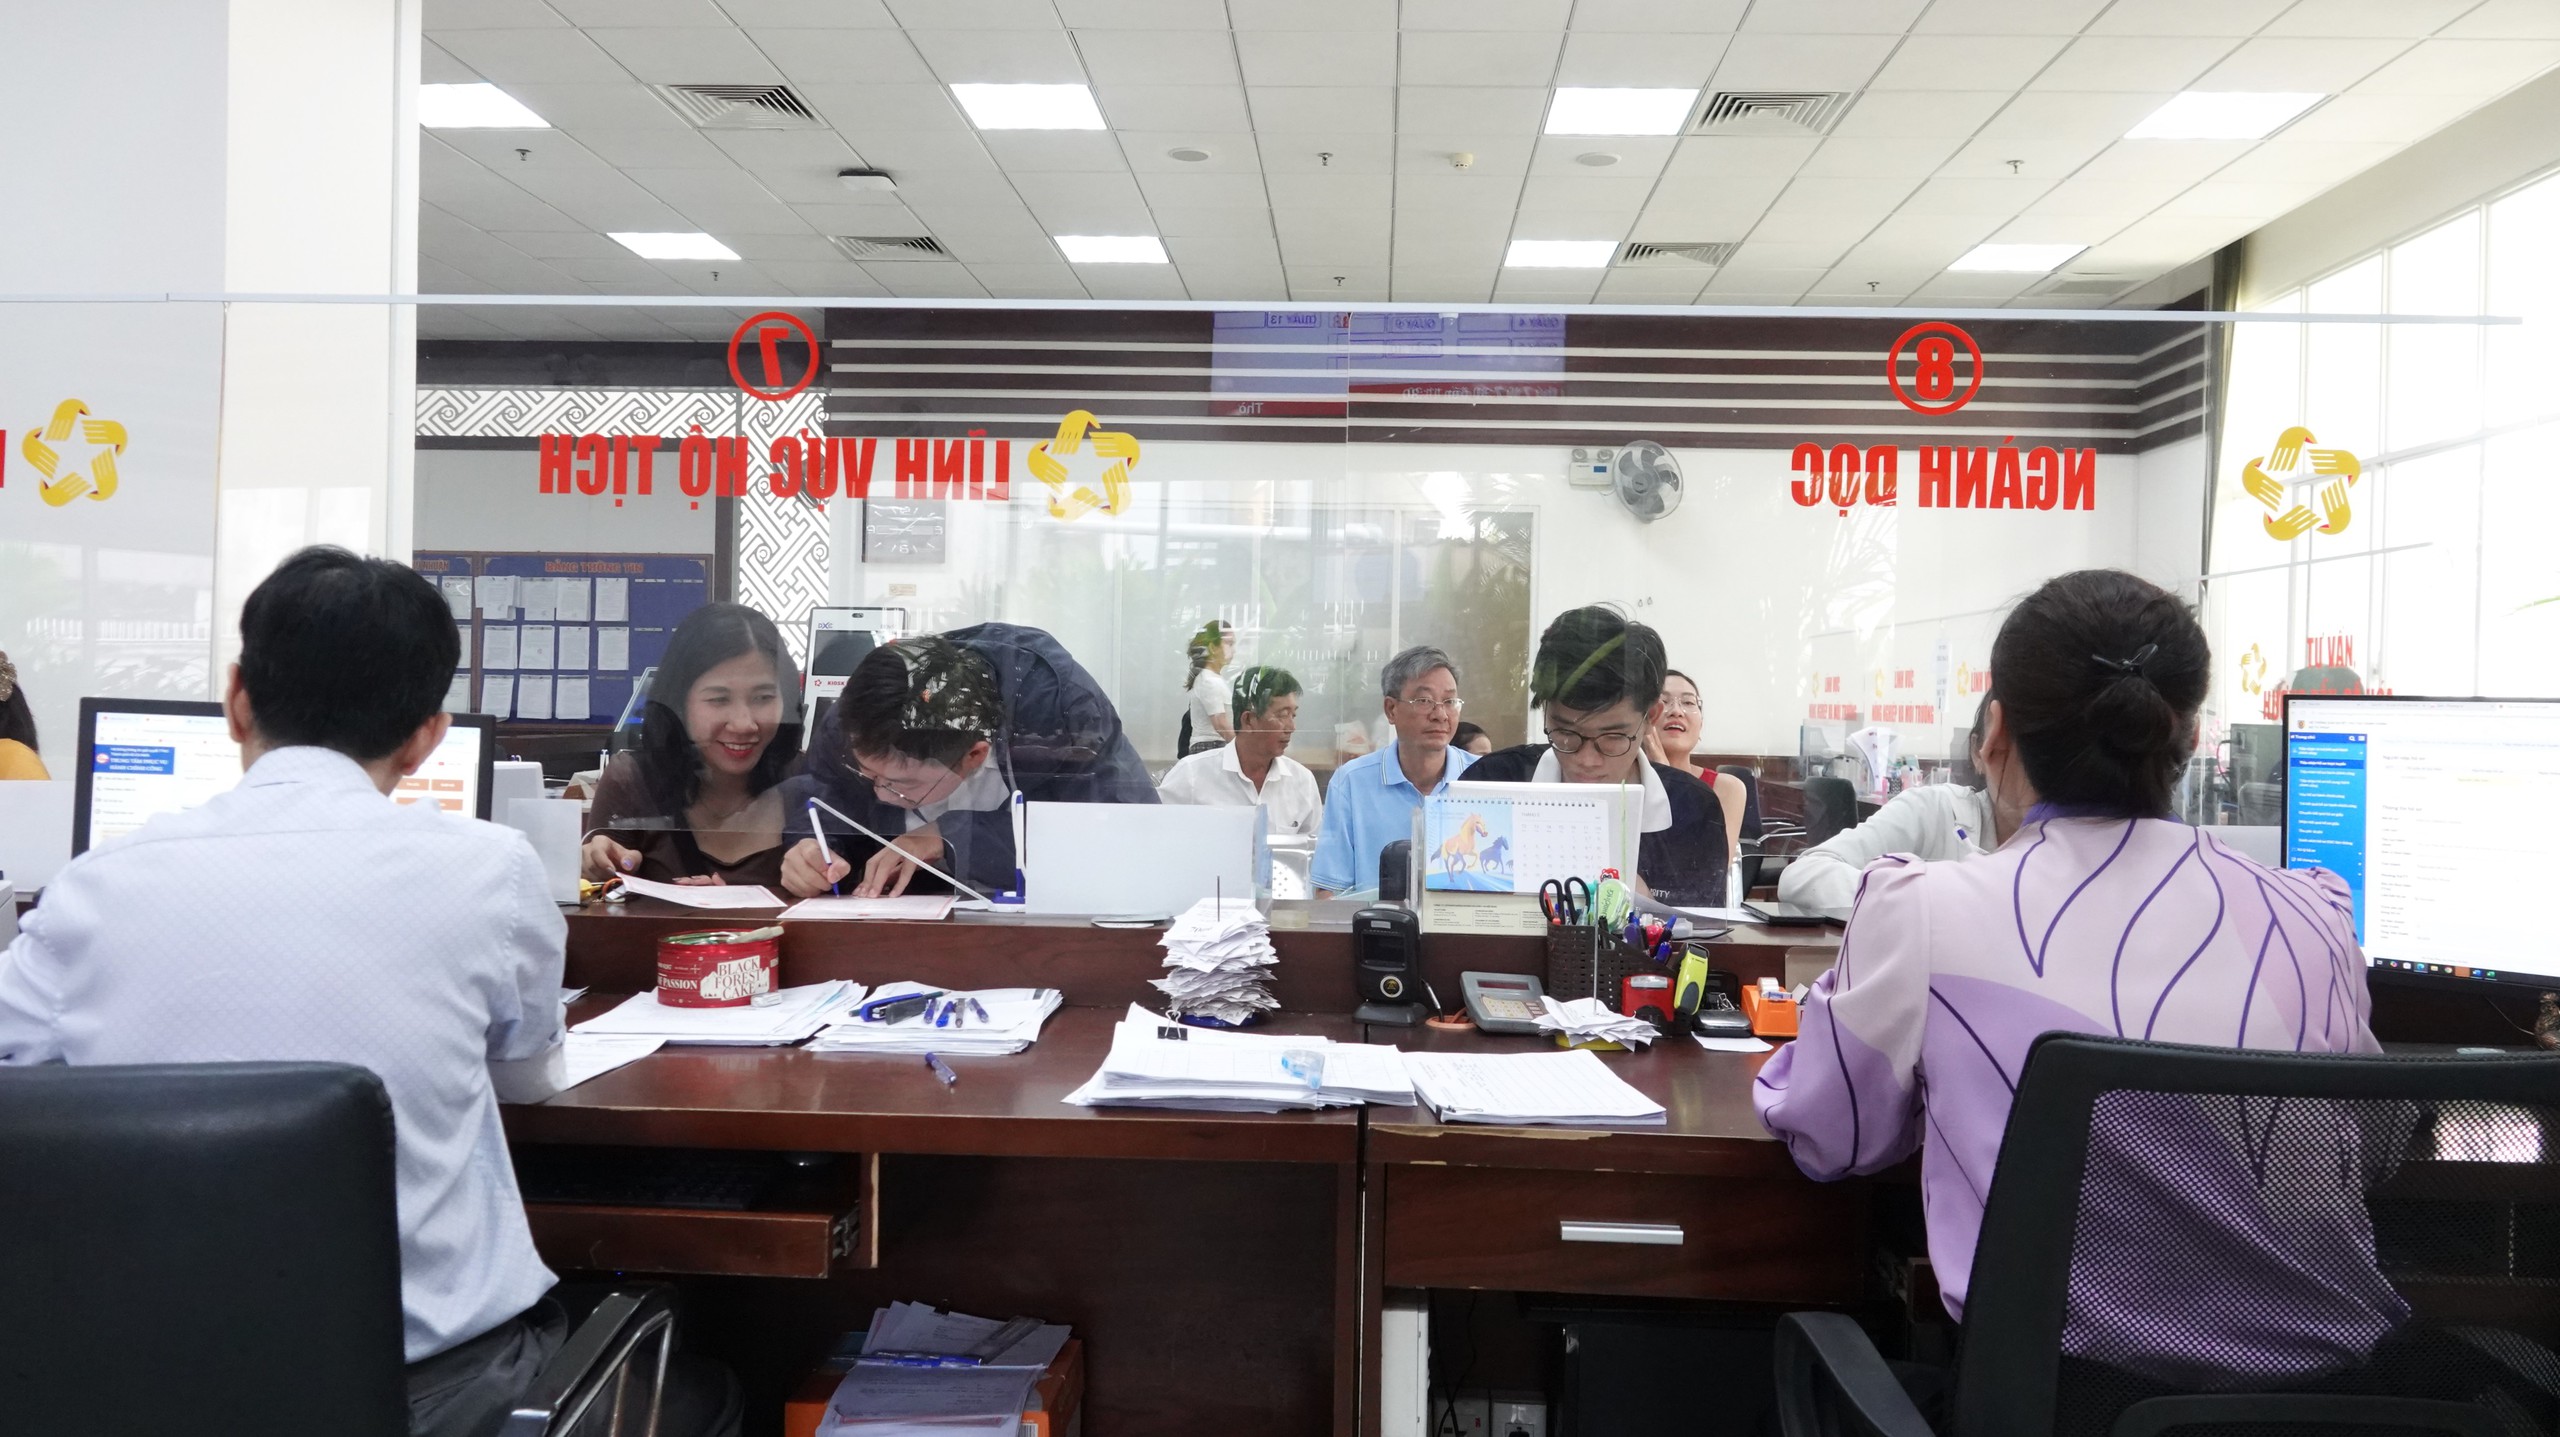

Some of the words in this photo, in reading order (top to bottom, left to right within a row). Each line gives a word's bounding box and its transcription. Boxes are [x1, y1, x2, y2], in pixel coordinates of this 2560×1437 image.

[623, 561, 644, 574] TIN
[719, 957, 759, 976] BLACK
[663, 977, 698, 990] PASSION
[715, 970, 761, 989] FOREST
[722, 983, 756, 1000] CAKE
